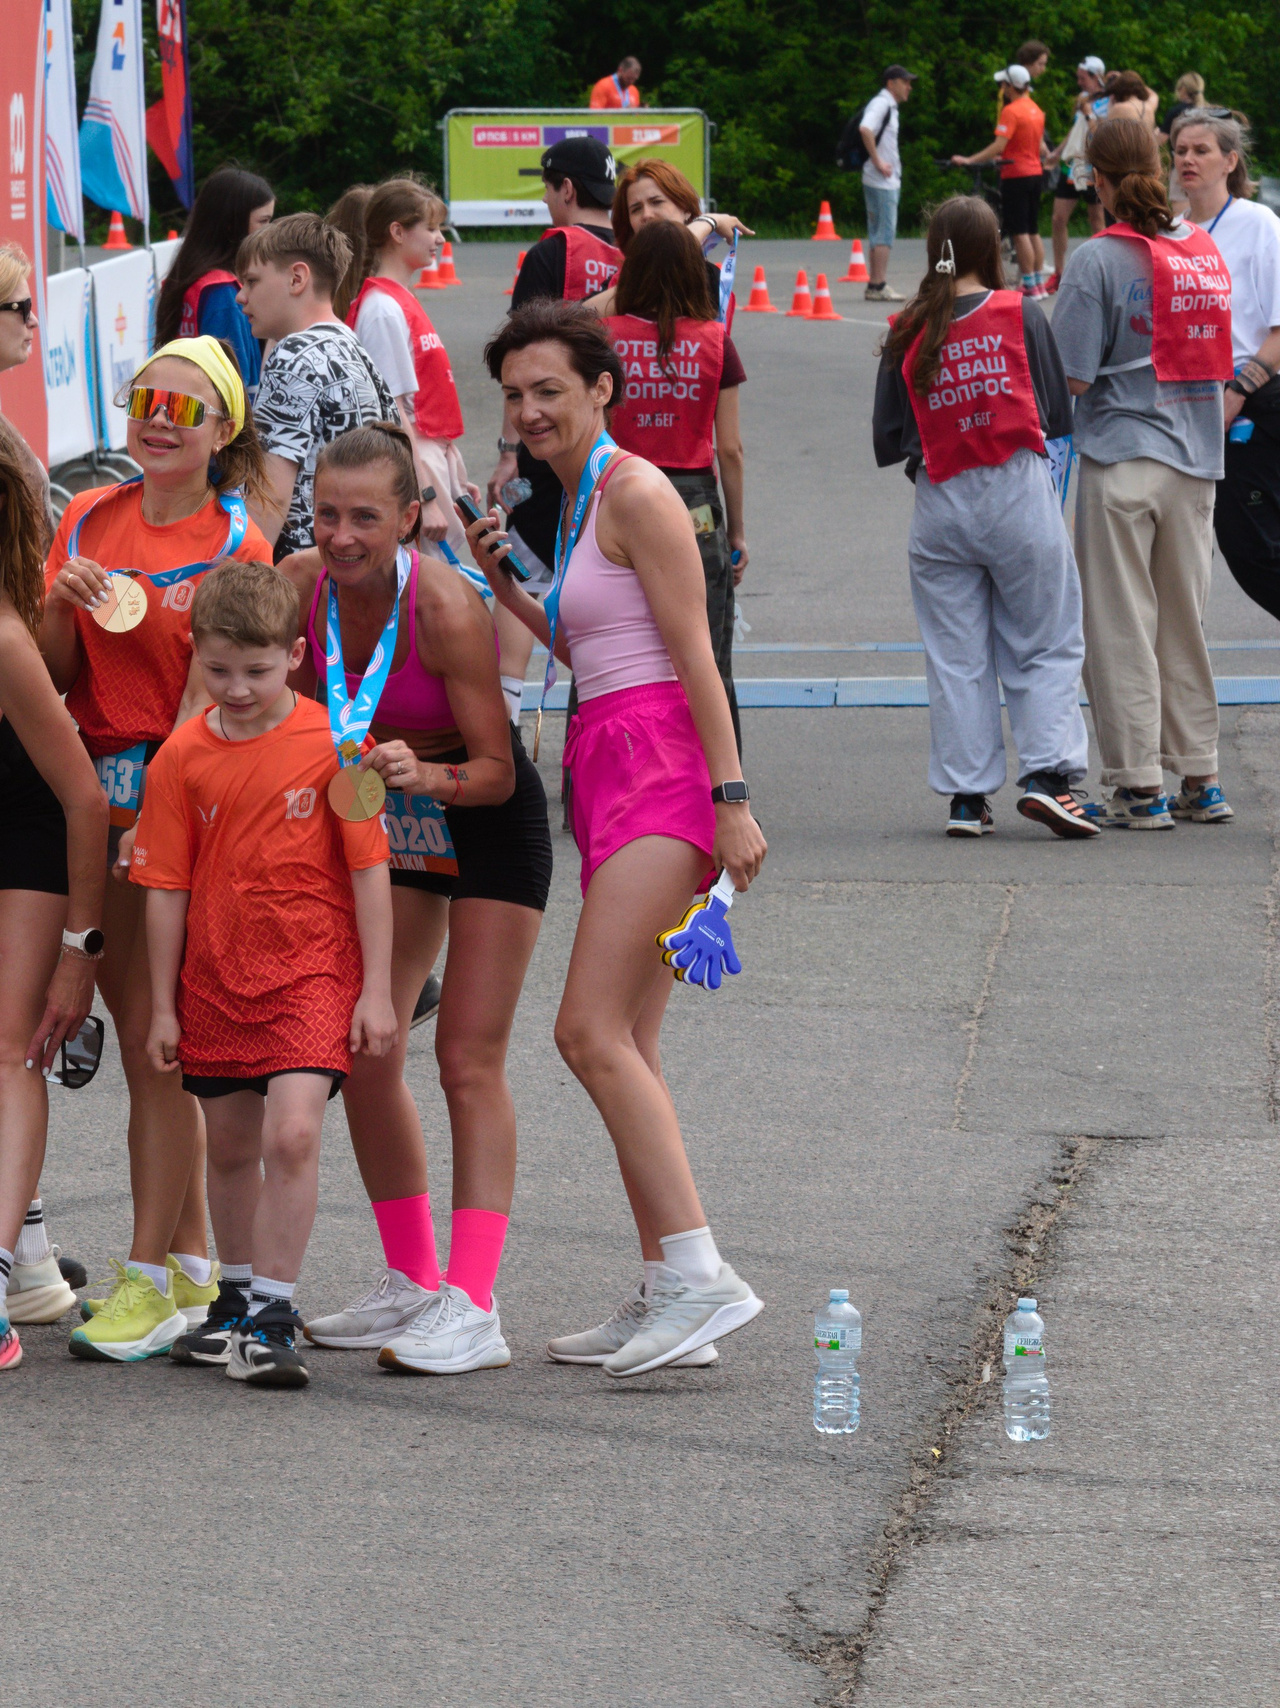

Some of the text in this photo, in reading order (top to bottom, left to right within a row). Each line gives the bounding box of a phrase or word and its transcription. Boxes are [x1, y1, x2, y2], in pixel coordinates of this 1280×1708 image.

[1173, 273, 1230, 292] НА ВАШ
[1202, 324, 1219, 340] БЕГ
[614, 339, 701, 358] ОТВЧУ
[940, 334, 1003, 363] ТВЕЧУ
[957, 355, 1007, 381] ВАШ
[625, 382, 701, 402] ОПРОС
[928, 377, 1013, 411] ВОПРОС
[654, 411, 675, 428] БЕГ
[974, 410, 992, 427] БЕГ
[574, 494, 586, 521] ПСБ
[284, 787, 317, 820] 10
